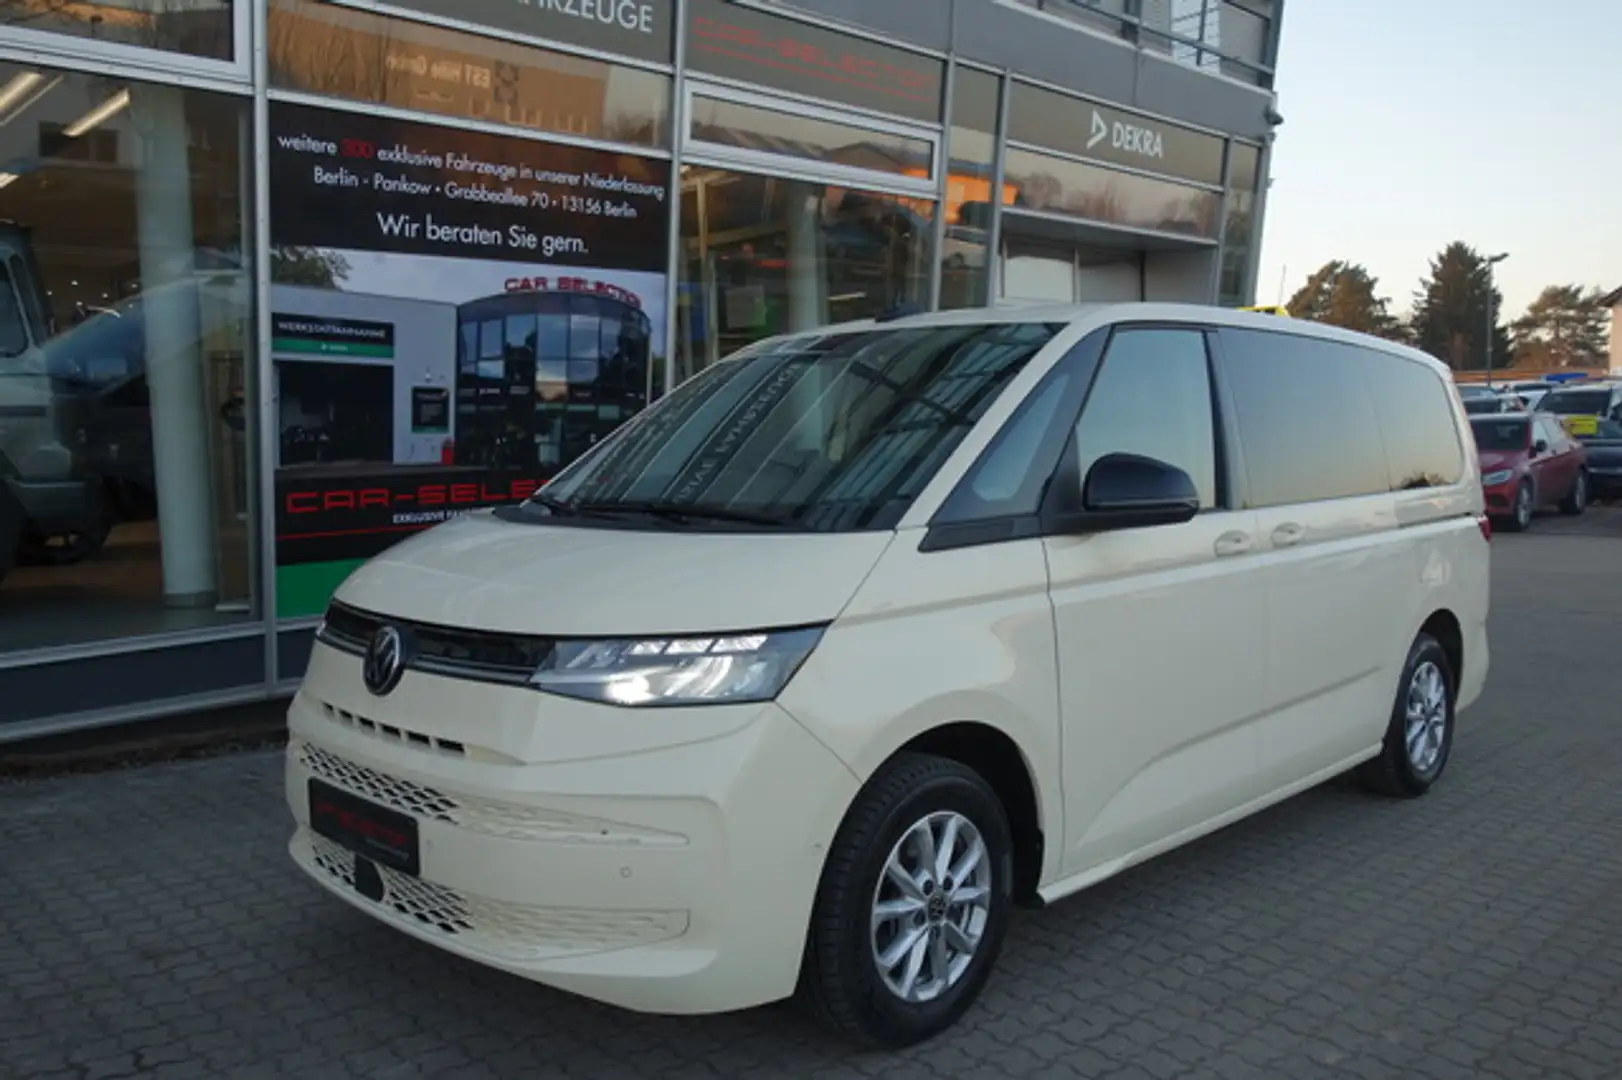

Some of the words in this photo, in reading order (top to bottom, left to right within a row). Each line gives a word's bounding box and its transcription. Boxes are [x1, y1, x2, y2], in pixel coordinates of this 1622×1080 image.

[1112, 121, 1163, 158] DEKRA
[277, 133, 338, 155] weitere
[377, 144, 443, 168] exklusive
[446, 152, 517, 181] Fahrzeuge
[535, 169, 580, 186] unserer
[583, 172, 665, 202] Niederlassung
[314, 165, 359, 187] Berlin
[373, 172, 431, 194] Pankow
[530, 190, 549, 209] 70
[562, 194, 601, 214] 13156
[604, 200, 637, 219] Berlin
[376, 211, 421, 238] Wir
[426, 213, 502, 246] beraten
[508, 224, 538, 250] Sie
[542, 235, 589, 257] gern.
[504, 276, 549, 292] CAR
